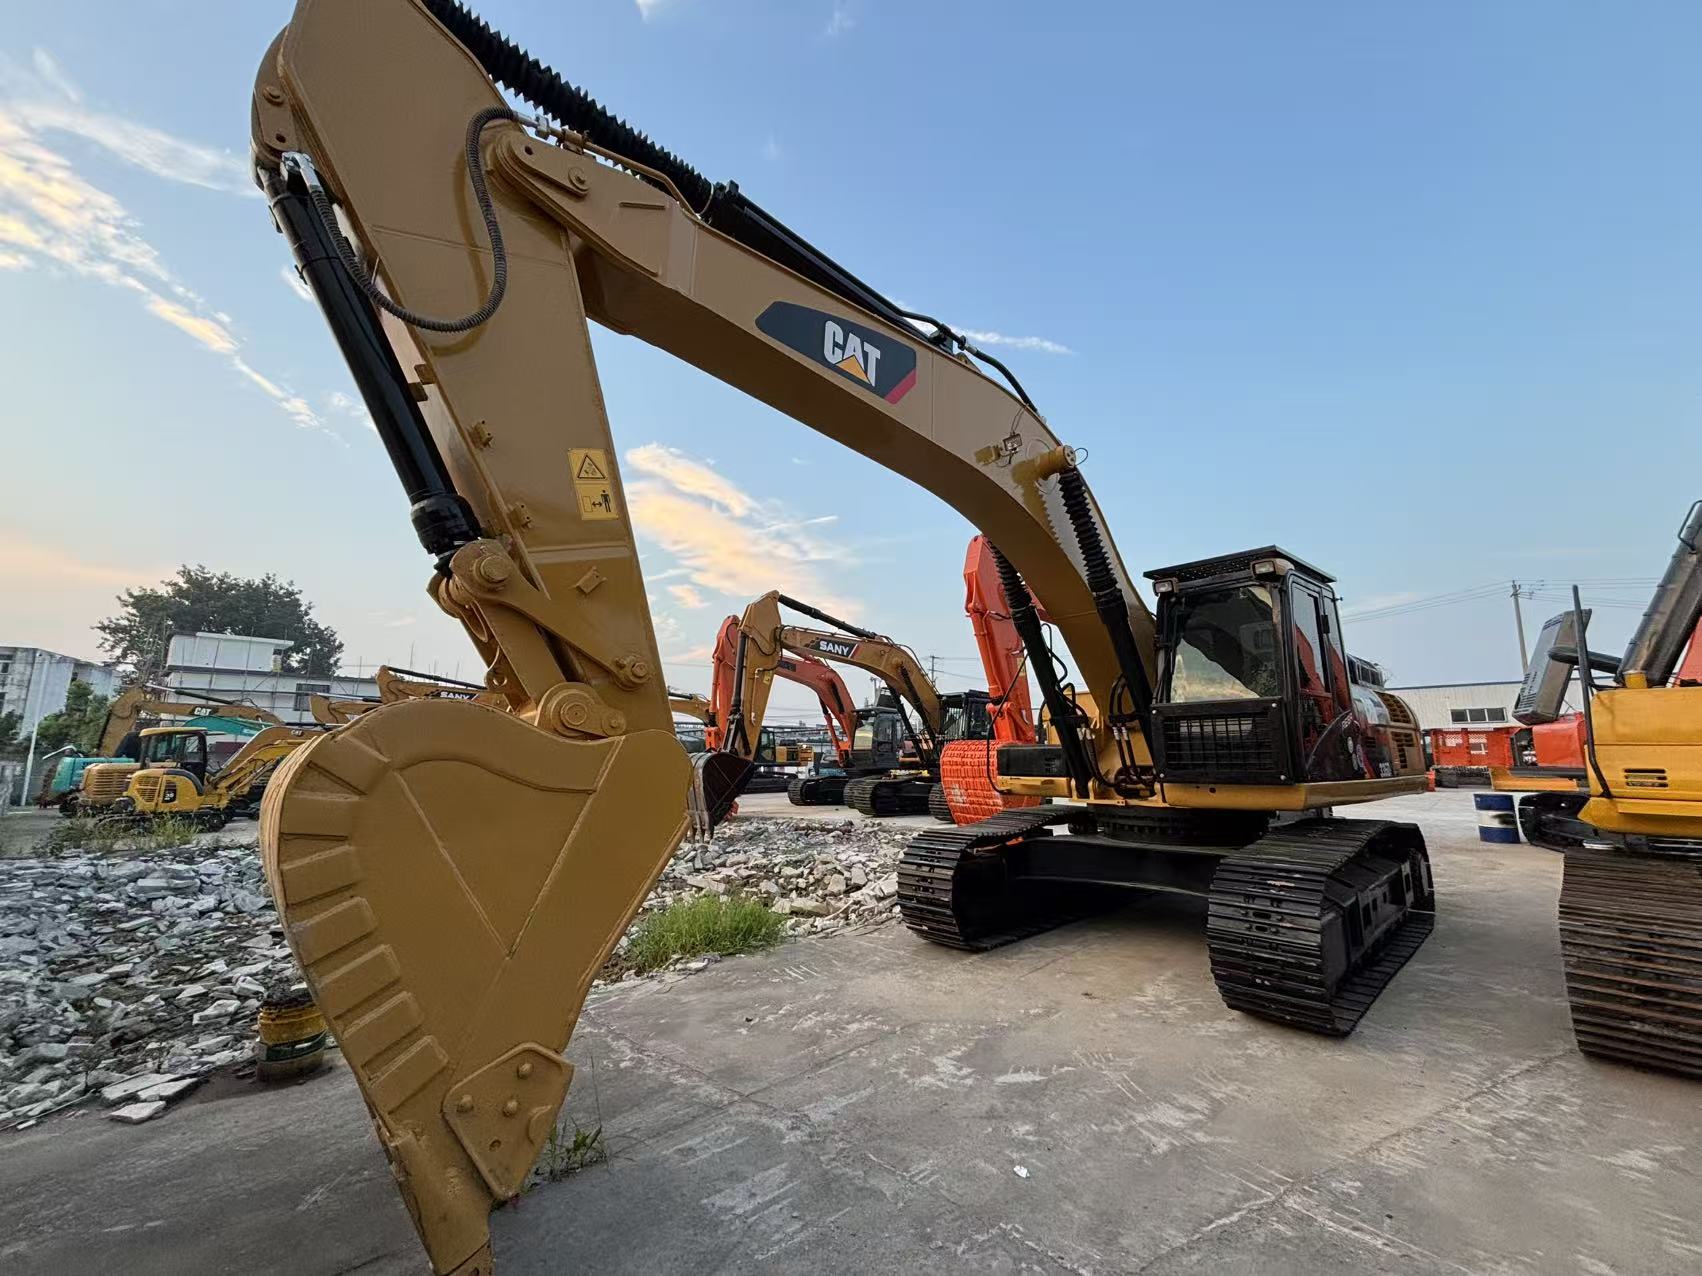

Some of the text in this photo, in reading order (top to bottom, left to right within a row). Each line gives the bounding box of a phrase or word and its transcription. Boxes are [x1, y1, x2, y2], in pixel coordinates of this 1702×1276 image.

[824, 321, 881, 387] CAT
[820, 640, 849, 655] SANY
[194, 707, 212, 715] CAT
